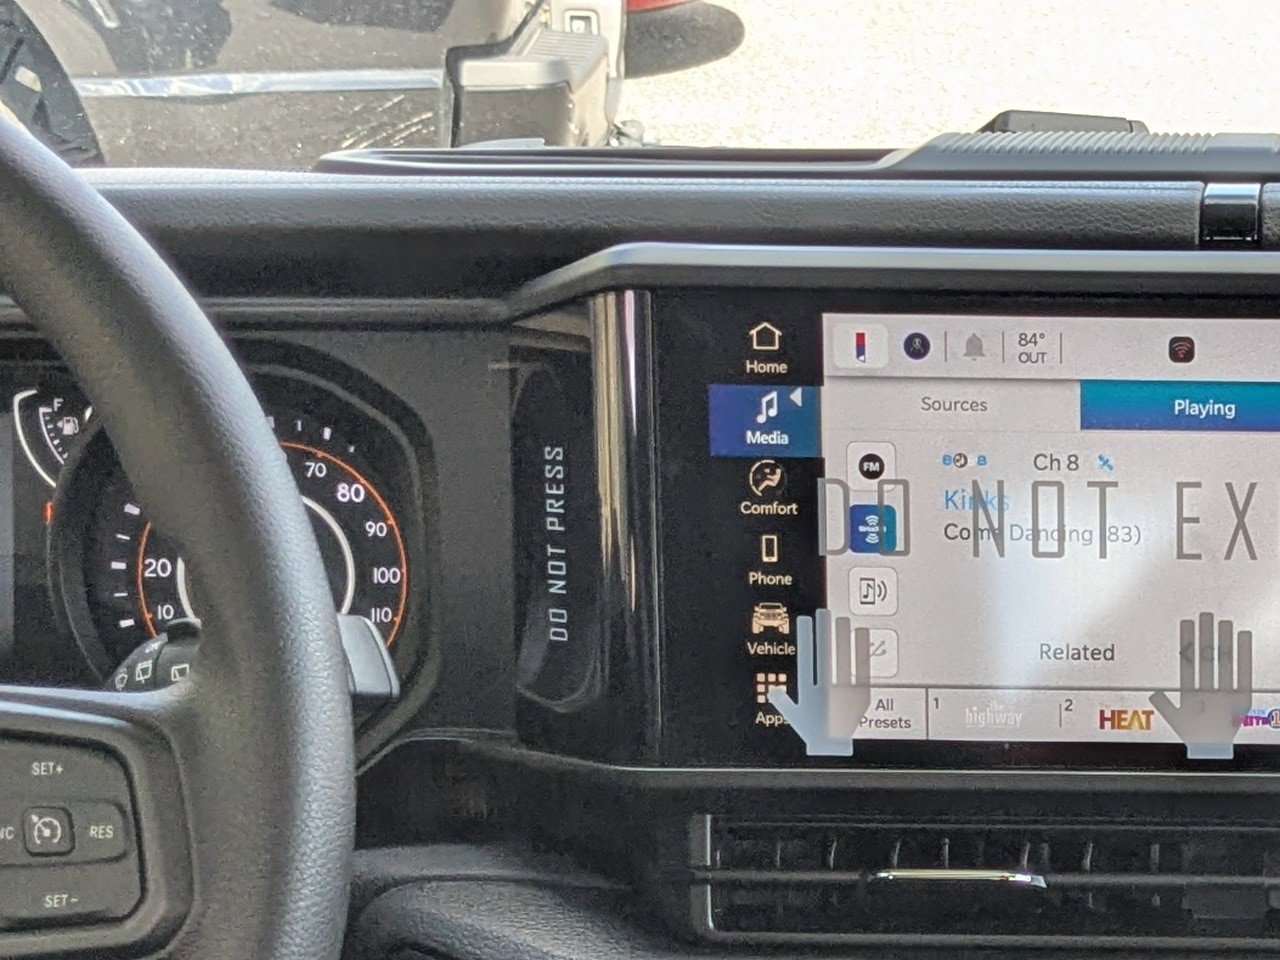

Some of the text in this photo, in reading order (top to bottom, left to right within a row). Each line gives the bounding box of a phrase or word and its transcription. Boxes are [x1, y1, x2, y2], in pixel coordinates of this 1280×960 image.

[1017, 332, 1046, 348] 84°
[1017, 351, 1048, 364] OUT
[745, 360, 788, 374] Home
[920, 396, 988, 413] Sources
[1173, 399, 1236, 419] Playing
[745, 430, 789, 445] Media
[304, 462, 328, 478] 70
[862, 462, 881, 472] FM
[1032, 453, 1080, 472] Ch 8
[336, 483, 366, 503] 80
[739, 500, 799, 516] Comfort
[971, 478, 1119, 560] NOT
[365, 521, 388, 537] 90
[544, 446, 569, 642] DO NOT PRESS
[143, 557, 172, 578] 20
[372, 567, 401, 584] 100
[748, 571, 794, 586] Phone
[156, 604, 175, 620] 10
[370, 606, 393, 623] 110
[745, 641, 797, 656] Vehicle
[1039, 642, 1116, 662] Related
[875, 698, 894, 712] All
[933, 697, 940, 710] 1
[1063, 699, 1074, 713] 2
[859, 716, 913, 730] Presets
[965, 707, 1023, 728] highway
[1098, 709, 1155, 731] HEAT
[89, 825, 115, 839] RES
